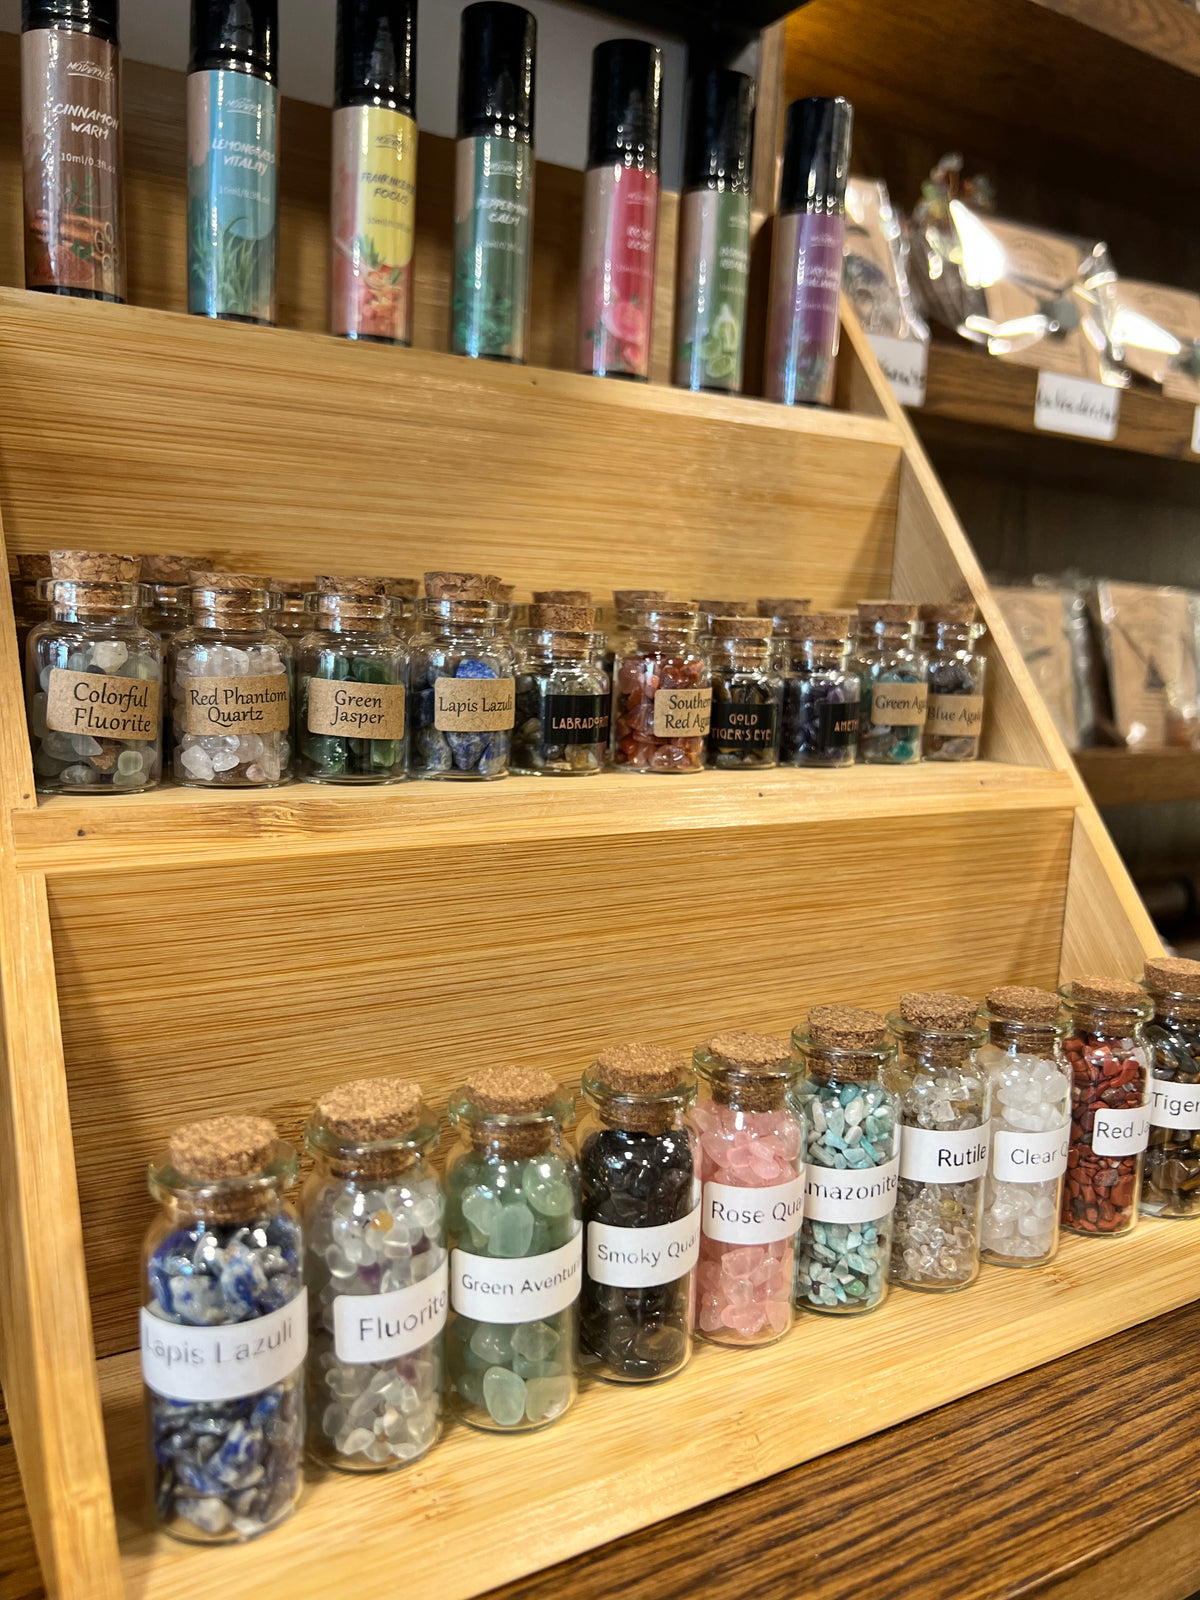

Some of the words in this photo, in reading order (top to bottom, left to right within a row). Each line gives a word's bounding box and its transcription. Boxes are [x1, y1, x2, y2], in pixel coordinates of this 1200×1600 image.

[55, 103, 119, 130] CINNAMON
[71, 122, 109, 140] WARM
[223, 154, 268, 177] VITALITY
[373, 187, 410, 206] FOCUS
[74, 682, 148, 712] Colorful
[190, 689, 218, 706] Red
[223, 686, 287, 706] Phantom
[334, 690, 383, 709] Green
[438, 697, 478, 717] Lapis
[482, 694, 513, 712] Lazuli
[875, 694, 910, 710] Green
[74, 707, 151, 732] Fluorite
[207, 706, 264, 728] Quartz
[330, 706, 385, 726] Jasper
[665, 712, 690, 729] Red
[728, 713, 758, 726] GOLD
[927, 705, 956, 721] Blue
[711, 728, 751, 740] TIGER'S
[753, 728, 772, 741] EYE
[1096, 1121, 1134, 1139] Red
[1137, 1119, 1151, 1137] Ja
[938, 1143, 987, 1167] Rutile
[1010, 1148, 1058, 1165] Clear
[804, 1173, 898, 1200] mazonite
[711, 1200, 765, 1224] Rose
[597, 1244, 661, 1268] Smoky
[461, 1273, 514, 1295] Green
[359, 1290, 447, 1341] Fluorite
[143, 1326, 204, 1366] Lapis
[215, 1318, 292, 1364] Lazuli
